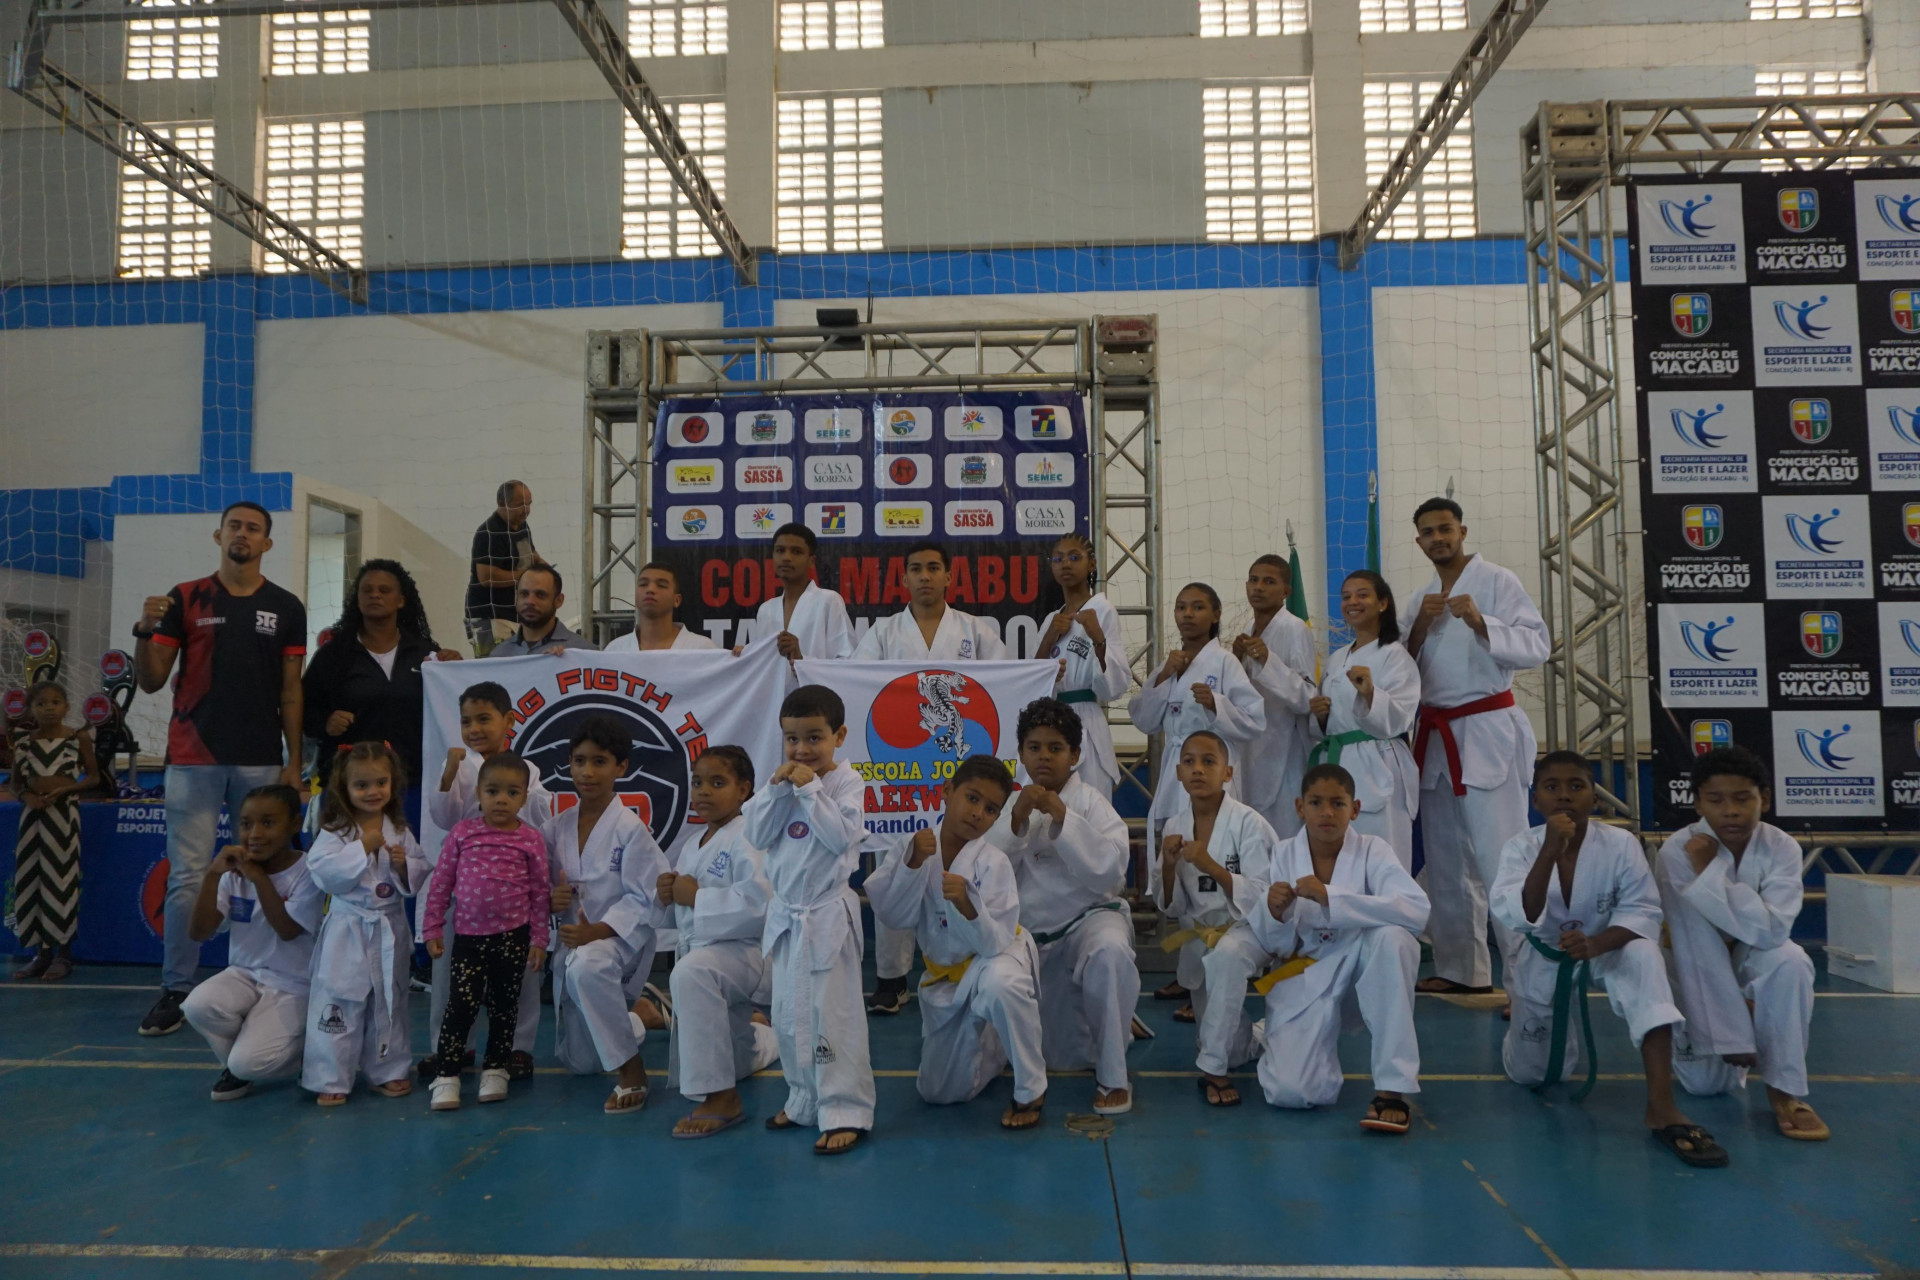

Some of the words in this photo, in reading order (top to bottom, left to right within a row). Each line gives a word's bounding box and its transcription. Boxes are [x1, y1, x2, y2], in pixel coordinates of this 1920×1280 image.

[1756, 244, 1826, 256] CONCEIÇÃO
[1829, 246, 1845, 254] DE
[1867, 250, 1910, 258] ESPORTE
[1651, 255, 1693, 263] ESPORTE
[1705, 254, 1735, 262] LAZER
[1758, 255, 1847, 269] MACABU
[1650, 348, 1719, 361] CONCEIÇÃO
[1722, 351, 1738, 359] DE
[1766, 357, 1808, 365] ESPORTE
[1821, 356, 1851, 364] LAZER
[1652, 360, 1739, 374] MACABU
[814, 462, 852, 474] CASA
[1768, 455, 1838, 468] CONCEIÇÃO
[1841, 457, 1858, 466] DE
[744, 466, 783, 483] SASSÁ
[1662, 465, 1704, 474] ESPORTE
[1717, 465, 1747, 473] LAZER
[1770, 466, 1859, 482] MACABU
[814, 475, 853, 483] MORENA
[954, 510, 994, 527] SASSÁ
[1025, 507, 1064, 519] CASA
[1025, 519, 1065, 527] MORENA
[1660, 562, 1730, 575] CONCEIÇÃO
[1733, 565, 1749, 573] DE
[1777, 571, 1820, 579] ESPORTE
[1824, 571, 1828, 579] E
[1833, 571, 1863, 579] LAZER
[839, 555, 1040, 604] MAABU
[1662, 573, 1750, 589] MACABU
[1778, 669, 1849, 682] CONCEIÇÃO
[1852, 672, 1869, 680] DE
[1671, 679, 1714, 687] ESPORTE
[1718, 679, 1722, 687] E
[1726, 679, 1757, 687] LAZER
[1780, 681, 1870, 696] MACABU
[556, 668, 673, 713] FIGTH
[851, 760, 923, 781] ESCOLA
[1787, 787, 1830, 796] ESPORTE
[1835, 788, 1839, 796] E
[1843, 788, 1874, 796] LAZER
